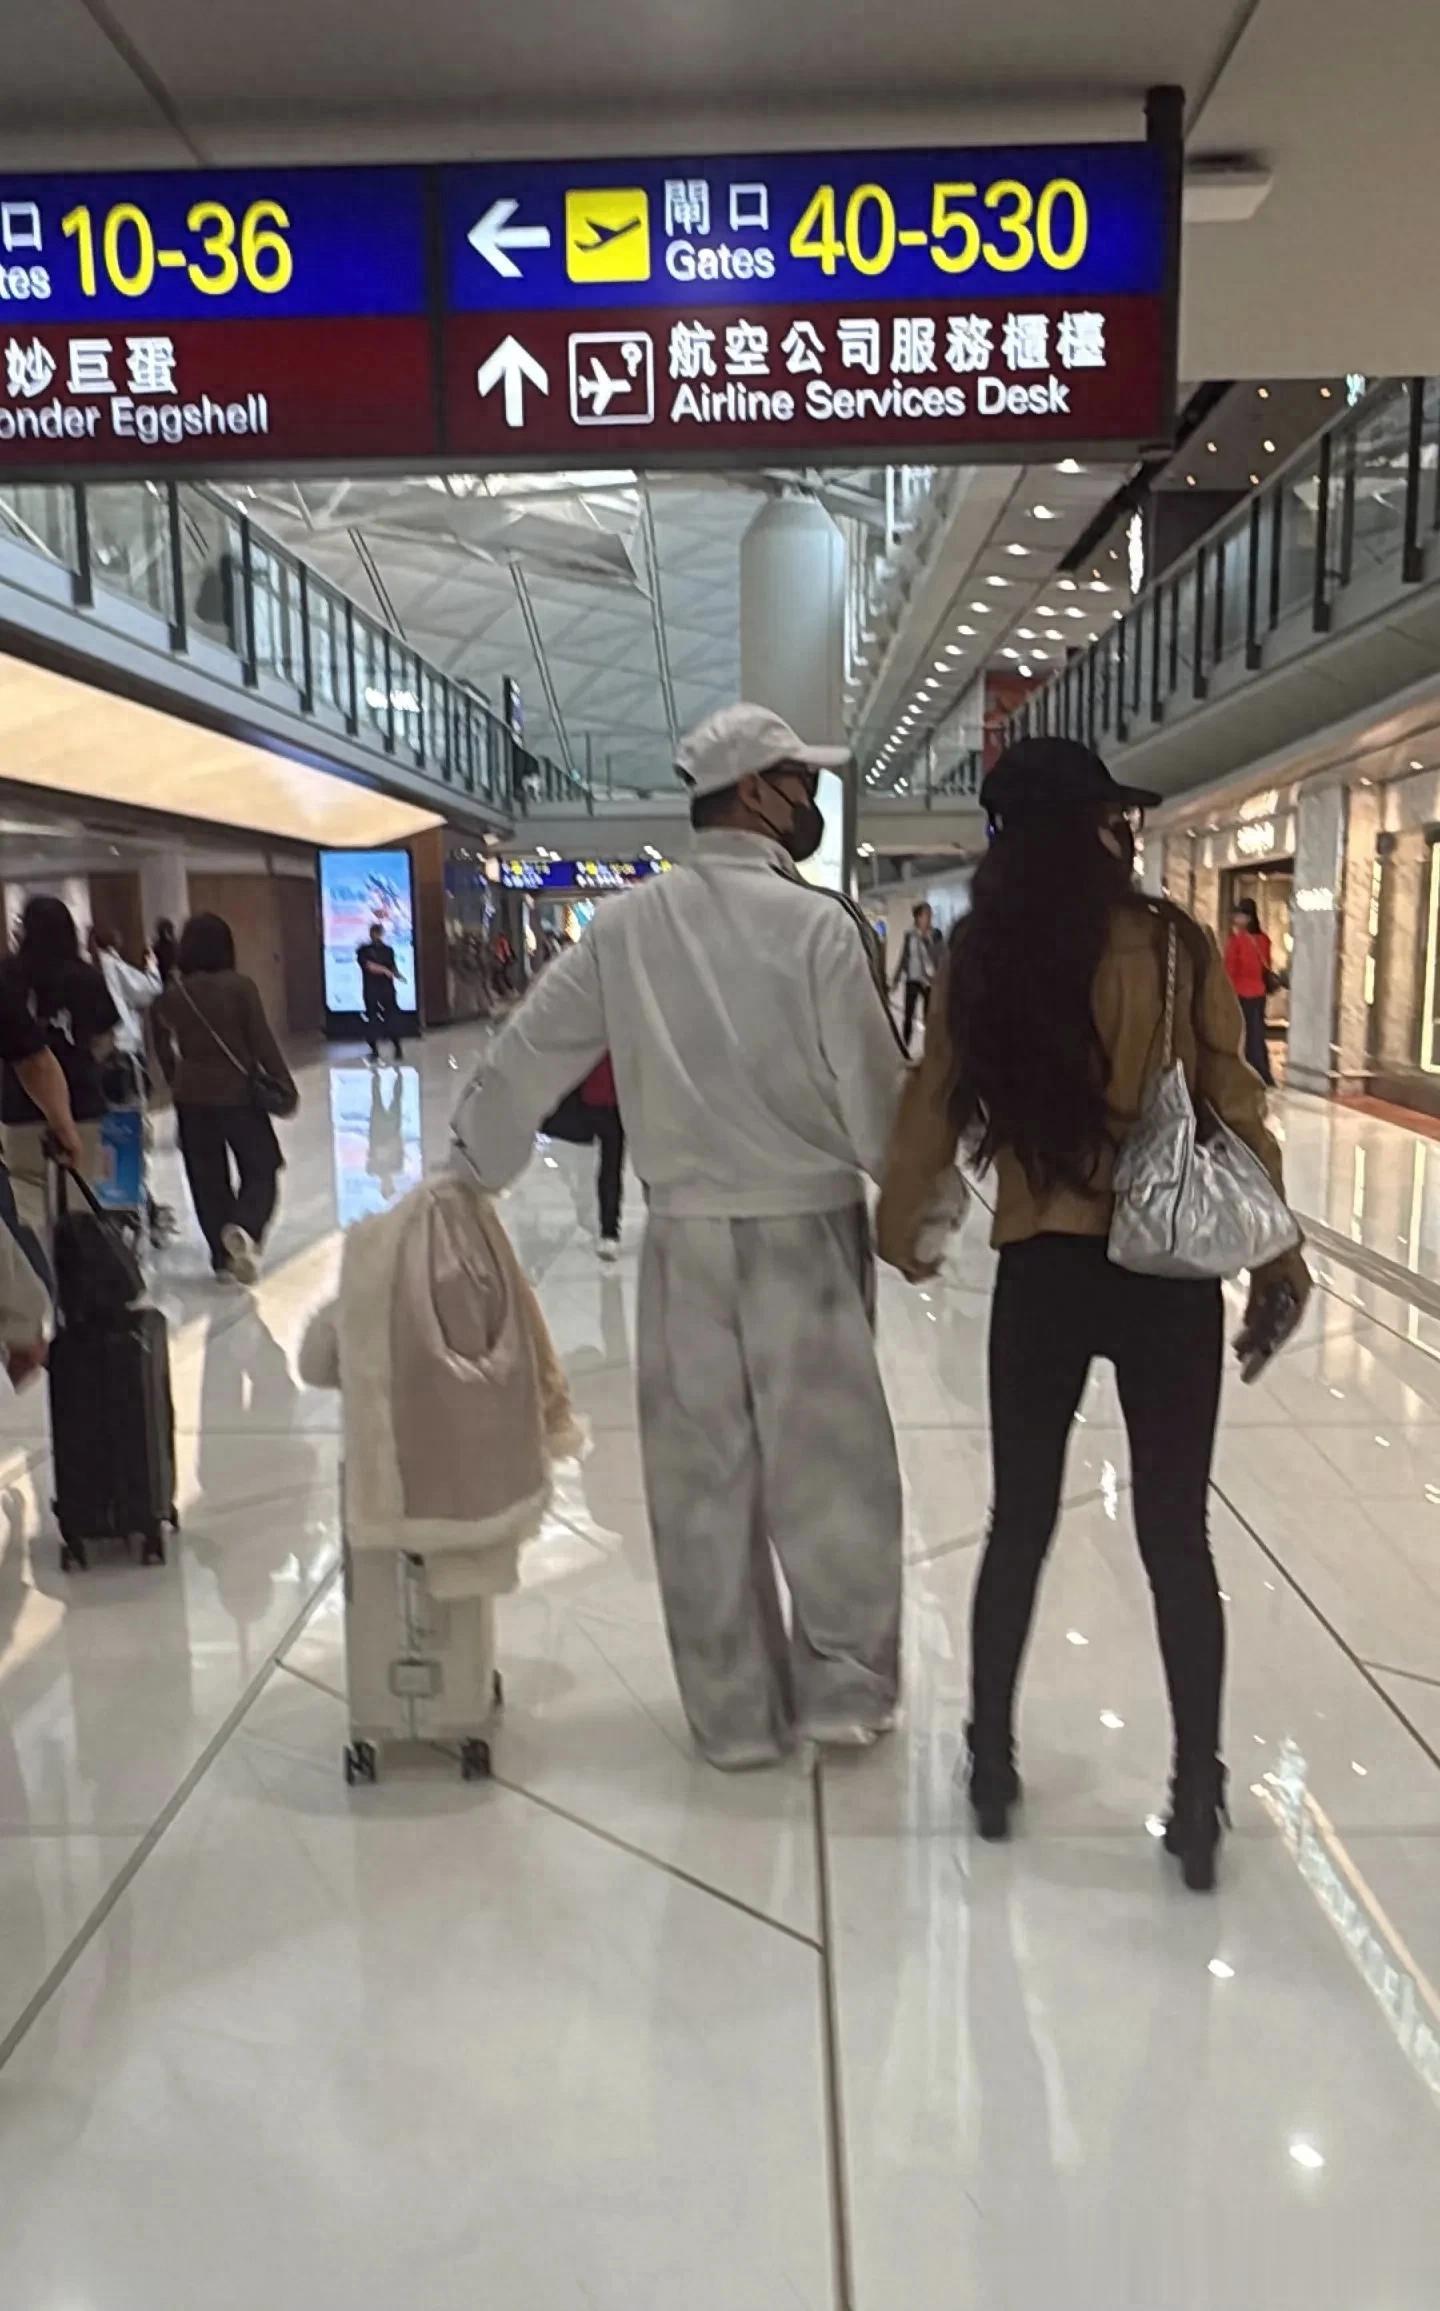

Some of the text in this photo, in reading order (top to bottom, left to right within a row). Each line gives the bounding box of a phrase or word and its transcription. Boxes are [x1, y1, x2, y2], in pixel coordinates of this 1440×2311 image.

[664, 179, 769, 235] 閘口
[790, 179, 1088, 276] 40-530
[62, 199, 293, 296] 10-36
[665, 240, 775, 281] Gates
[5, 337, 177, 397] 妙巨蛋
[0, 394, 268, 444] onder Eggshell
[671, 374, 1071, 423] Airline Services Desk
